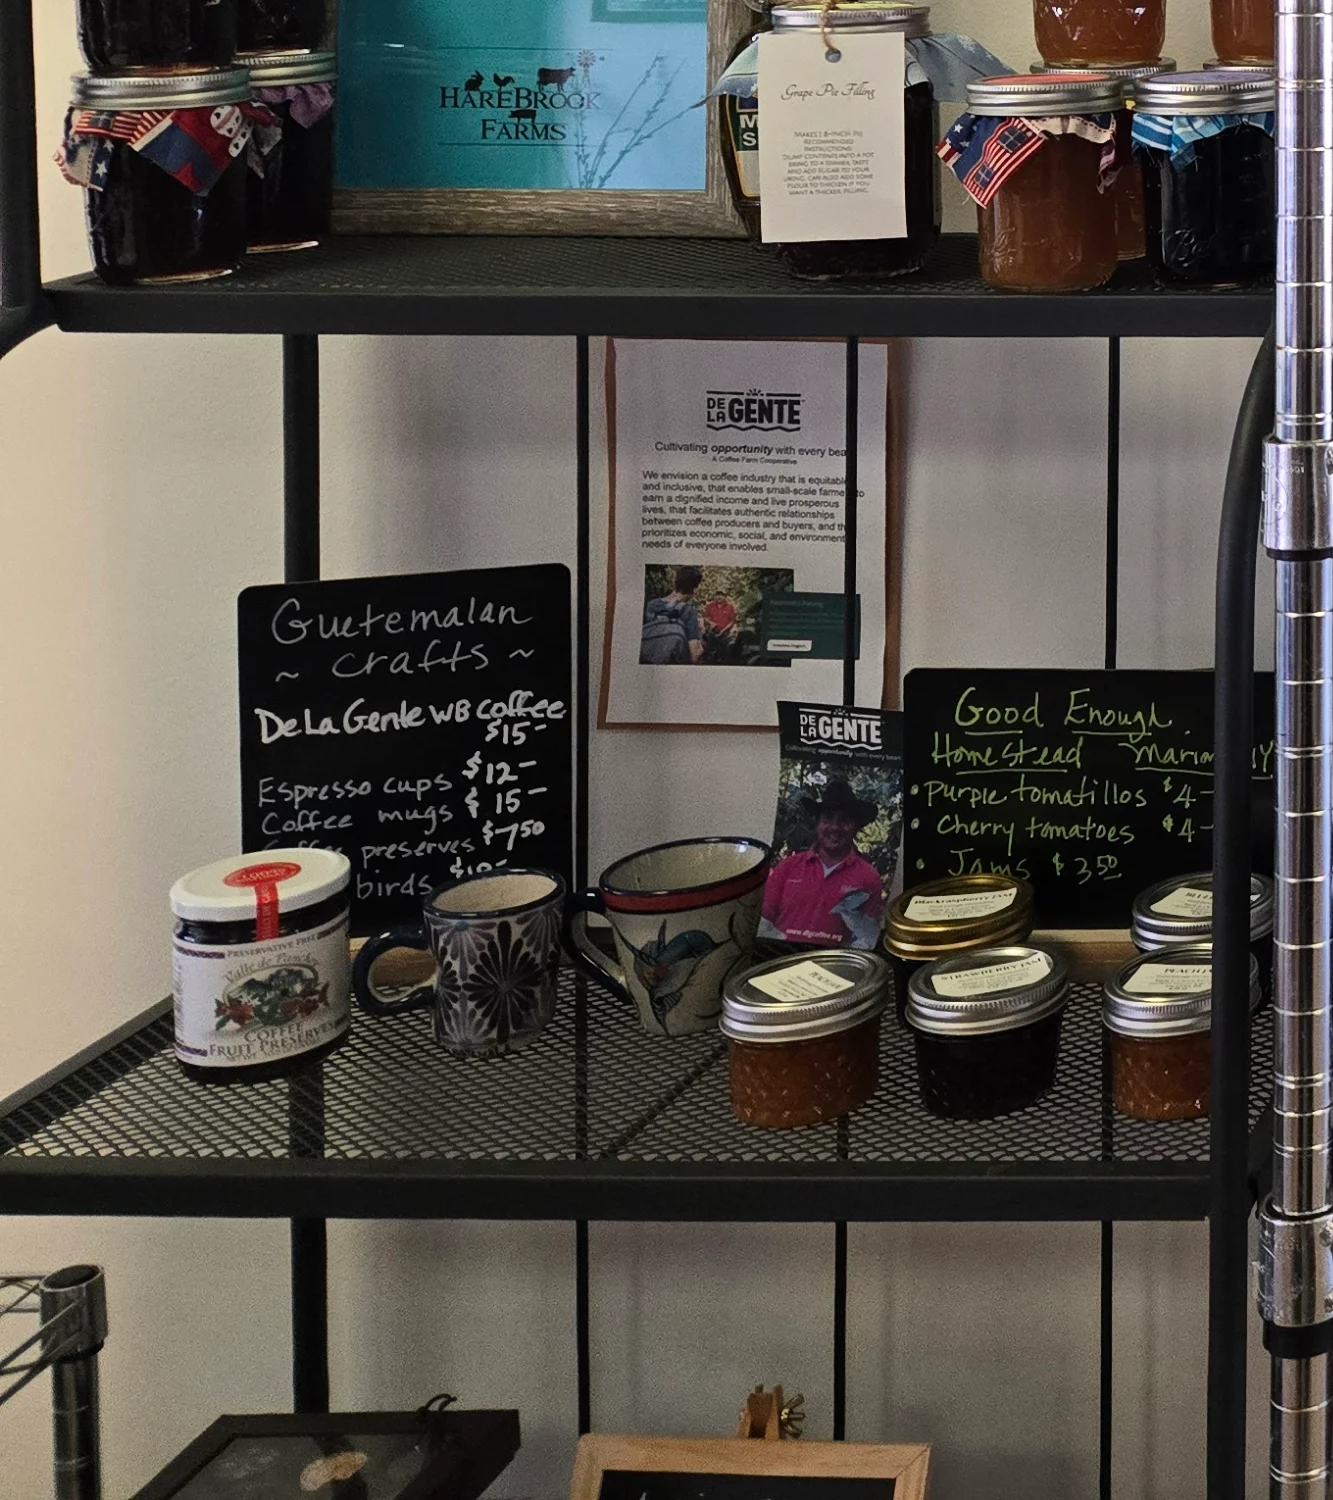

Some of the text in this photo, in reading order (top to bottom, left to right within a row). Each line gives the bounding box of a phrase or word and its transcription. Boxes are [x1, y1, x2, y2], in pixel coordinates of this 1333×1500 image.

[781, 81, 876, 101] Grape Pie Filling
[481, 118, 567, 140] FARMS
[706, 396, 800, 425] DE GENTE
[706, 410, 726, 423] LA
[654, 441, 826, 458] Cultivating opportunity with every
[428, 702, 472, 724] WB
[476, 689, 568, 721] coffee
[954, 686, 1172, 741] Good Enough
[800, 714, 882, 744] DE GENTE
[800, 726, 817, 738] LA
[258, 776, 372, 810] Espresso
[383, 772, 454, 800] cups
[1010, 774, 1148, 807] tomatillos
[261, 810, 354, 836] Coffee
[378, 805, 454, 836] mugs
[1025, 820, 1136, 845] tomatoes
[360, 835, 476, 869] preserves
[356, 869, 434, 899] birds
